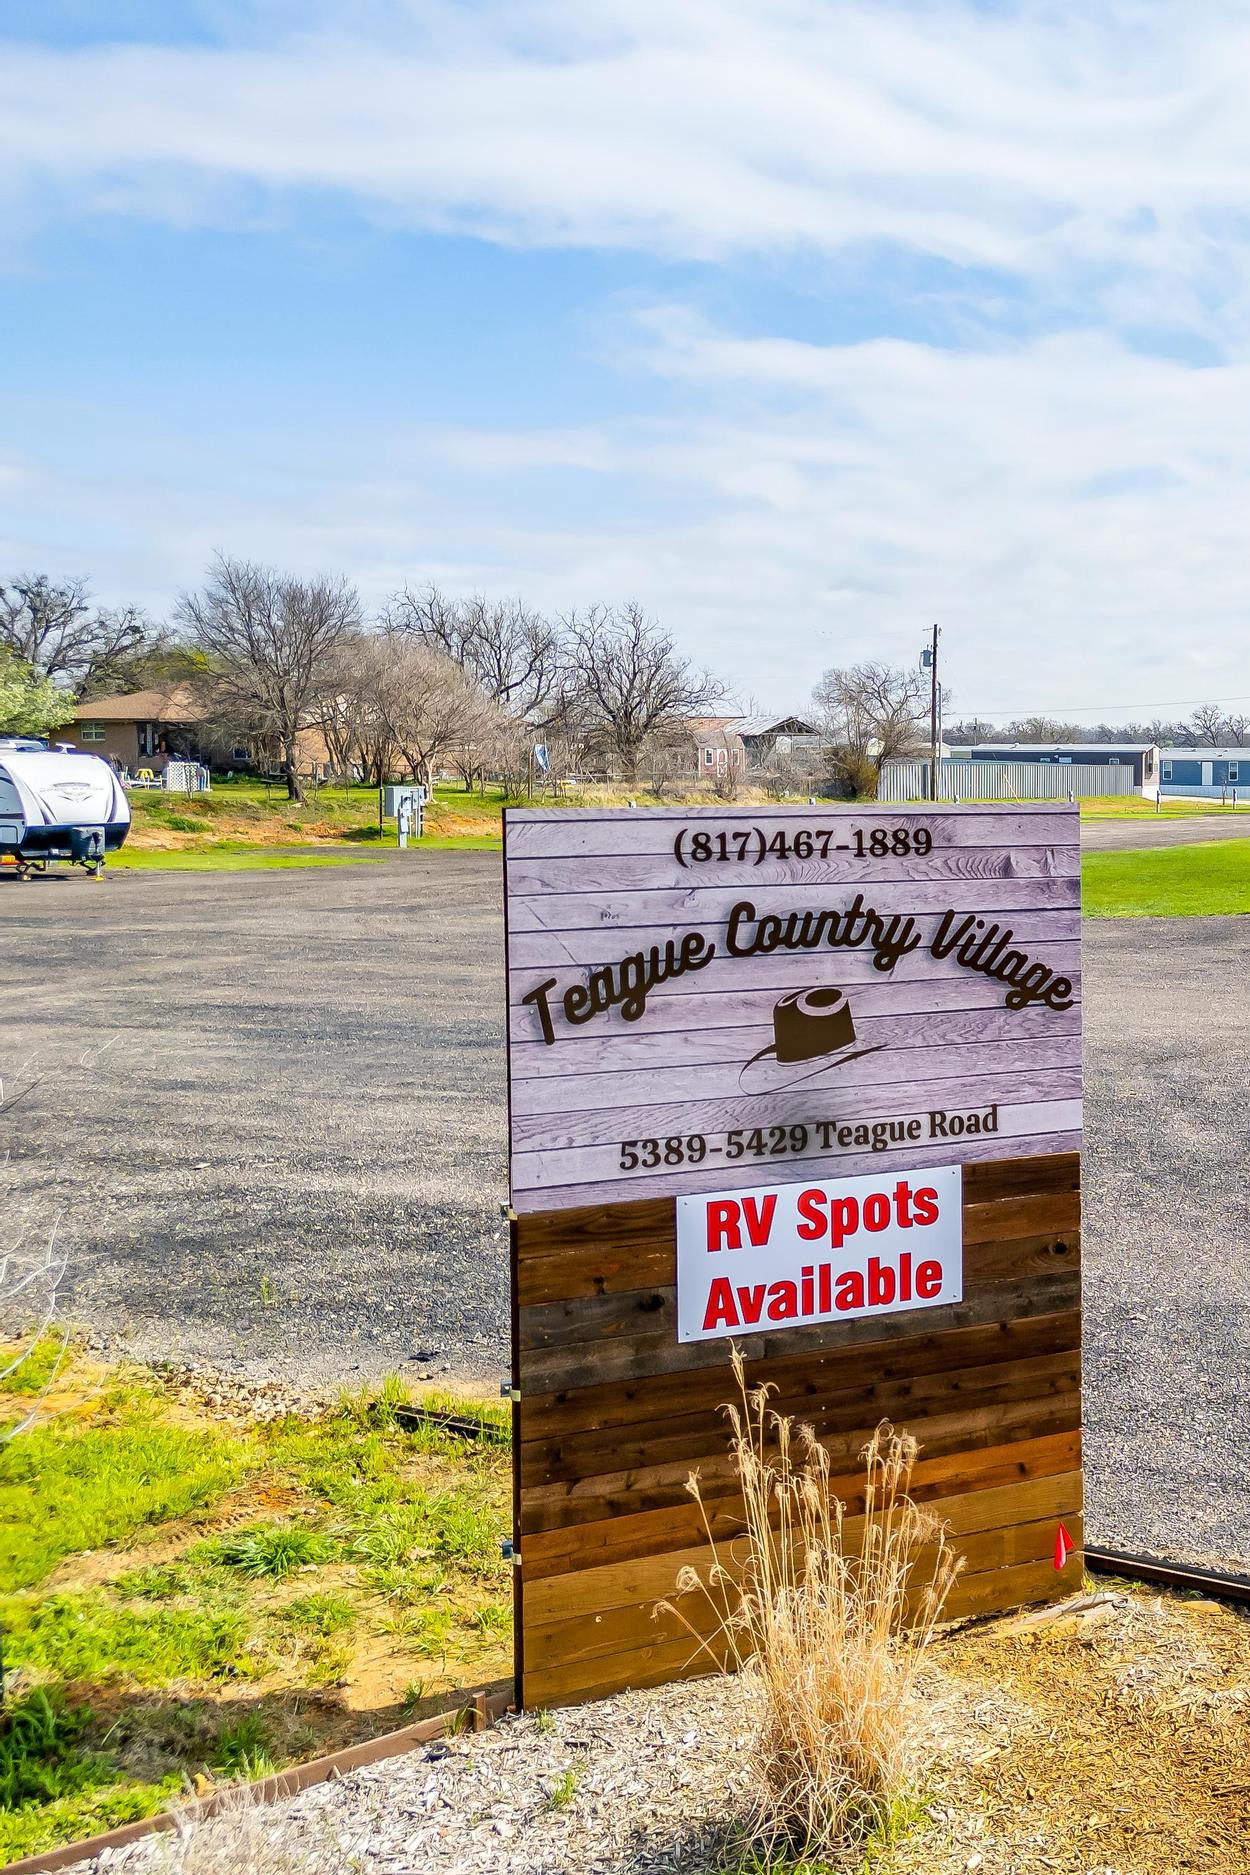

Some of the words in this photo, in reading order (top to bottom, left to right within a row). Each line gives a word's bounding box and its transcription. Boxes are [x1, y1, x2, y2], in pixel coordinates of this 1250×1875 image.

[674, 828, 933, 868] (817)467-1889
[522, 931, 716, 1045] Teague
[725, 893, 920, 972] Country
[930, 909, 1074, 1012] Village
[619, 1126, 808, 1170] 5389-5429
[816, 1117, 921, 1152] Teague
[928, 1104, 999, 1138] Road
[706, 1194, 778, 1252] RV
[797, 1180, 939, 1248] Spots
[702, 1252, 943, 1331] Available
